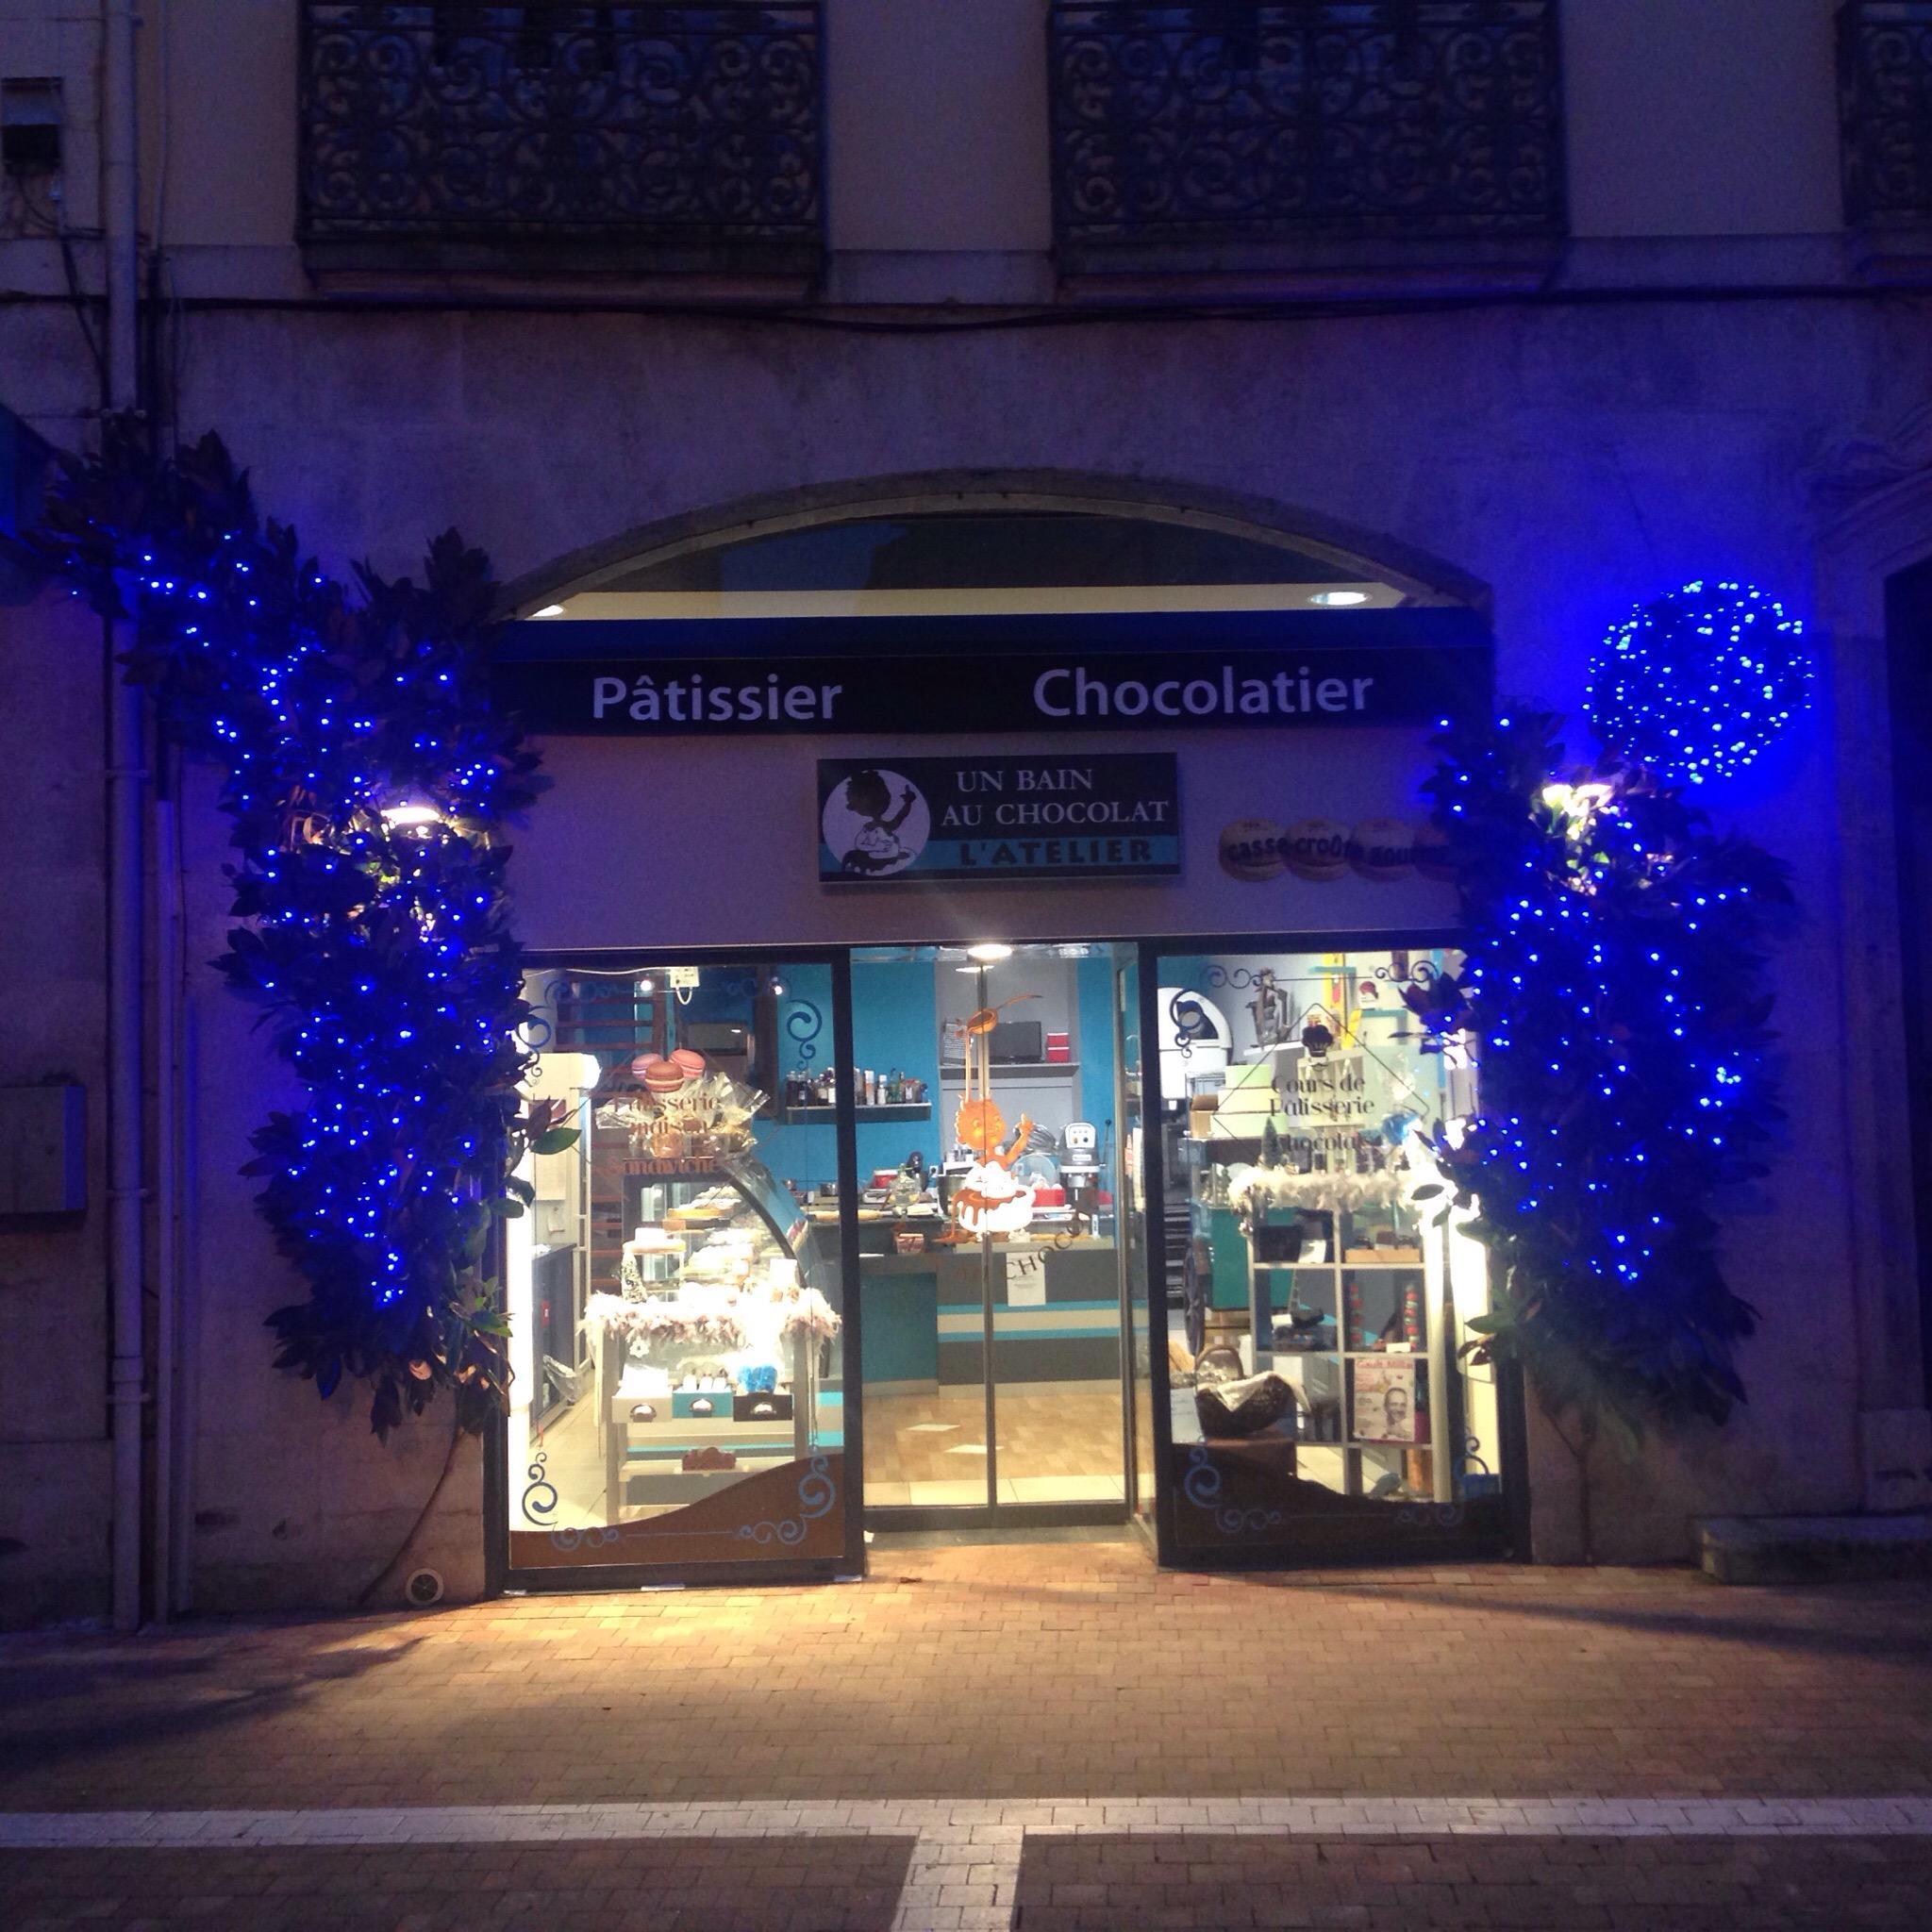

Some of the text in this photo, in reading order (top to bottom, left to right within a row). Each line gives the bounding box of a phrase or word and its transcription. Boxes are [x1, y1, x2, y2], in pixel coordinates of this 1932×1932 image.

[592, 666, 1374, 722] Pâtissier Chocolatier
[956, 768, 1093, 792] UN BAIN
[941, 800, 1170, 826] AU CHOCOLAT
[958, 839, 1154, 866] L'ATELIER
[1271, 1074, 1366, 1093] Cours de
[628, 1116, 708, 1134] maisn
